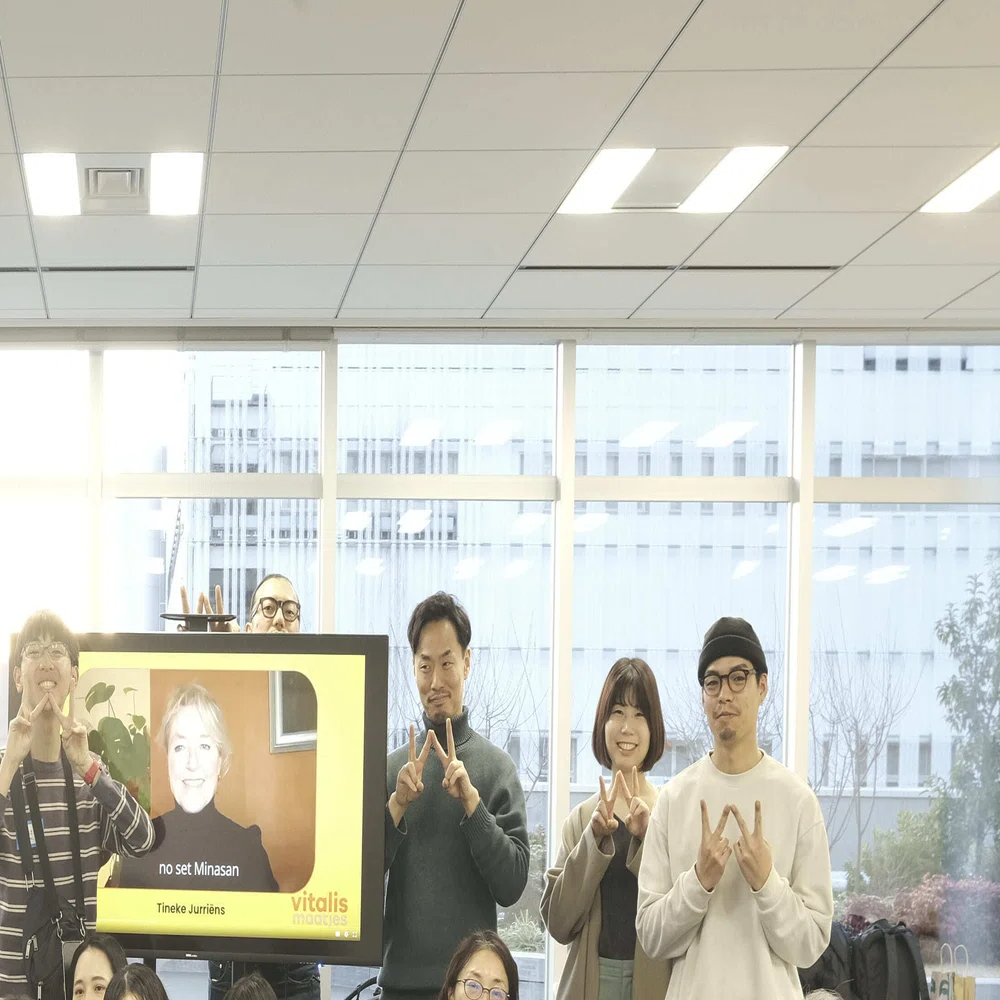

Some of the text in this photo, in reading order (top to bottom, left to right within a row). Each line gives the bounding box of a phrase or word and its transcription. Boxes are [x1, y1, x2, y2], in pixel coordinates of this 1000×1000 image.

[159, 861, 239, 877] no set Minasan
[157, 902, 226, 915] Tineke Jurriëns
[291, 890, 348, 913] vitalis
[292, 913, 348, 929] maatjes
